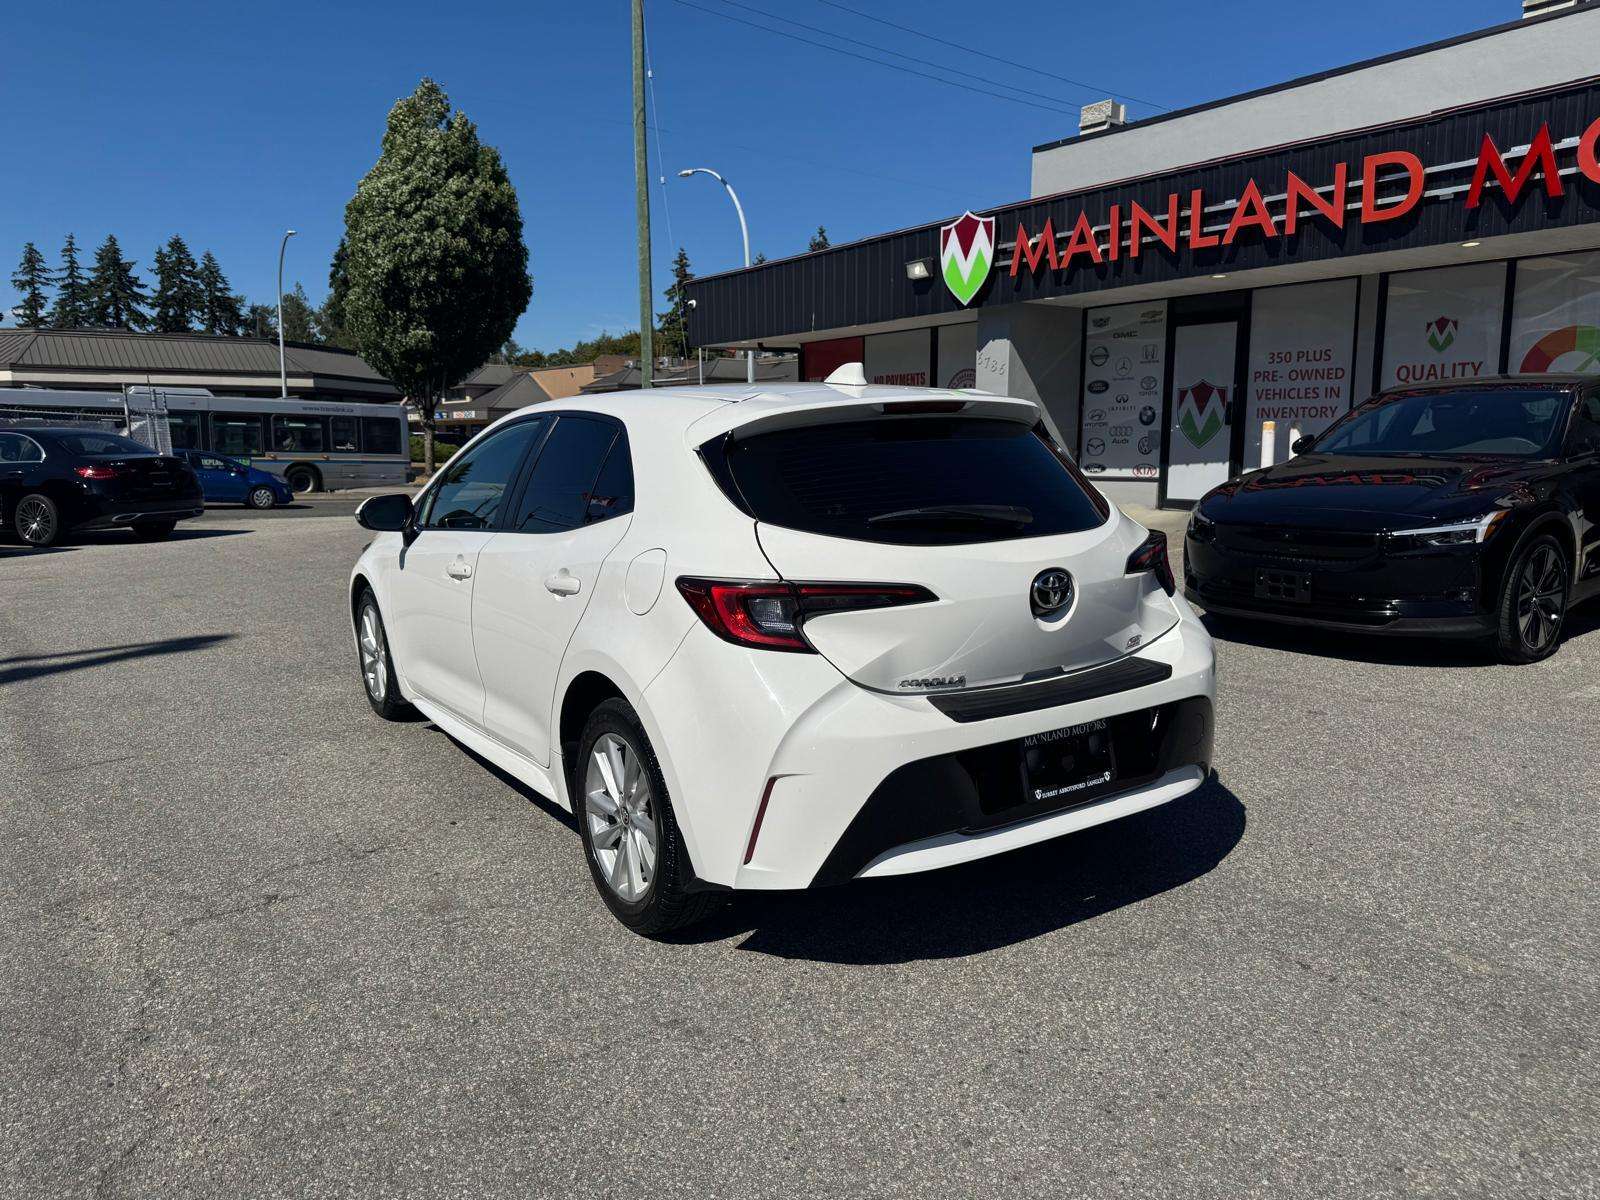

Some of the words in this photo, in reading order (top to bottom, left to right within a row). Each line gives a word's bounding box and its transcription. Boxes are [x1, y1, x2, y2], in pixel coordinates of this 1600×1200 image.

[1009, 151, 1425, 277] MAINLAND
[1268, 351, 1292, 365] 350
[1296, 348, 1332, 364] PLUS
[885, 372, 926, 386] PAYMENTS
[1288, 366, 1346, 382] OWNED
[1396, 360, 1484, 384] QUALITY
[1255, 386, 1320, 401] VEHICLES
[1325, 386, 1341, 400] IN
[1256, 405, 1339, 420] INVENTORY
[1112, 437, 1129, 445] Audi
[899, 675, 967, 688] COROLLA
[1024, 728, 1070, 747] MAINLAND
[1071, 719, 1107, 736] MOTORS
